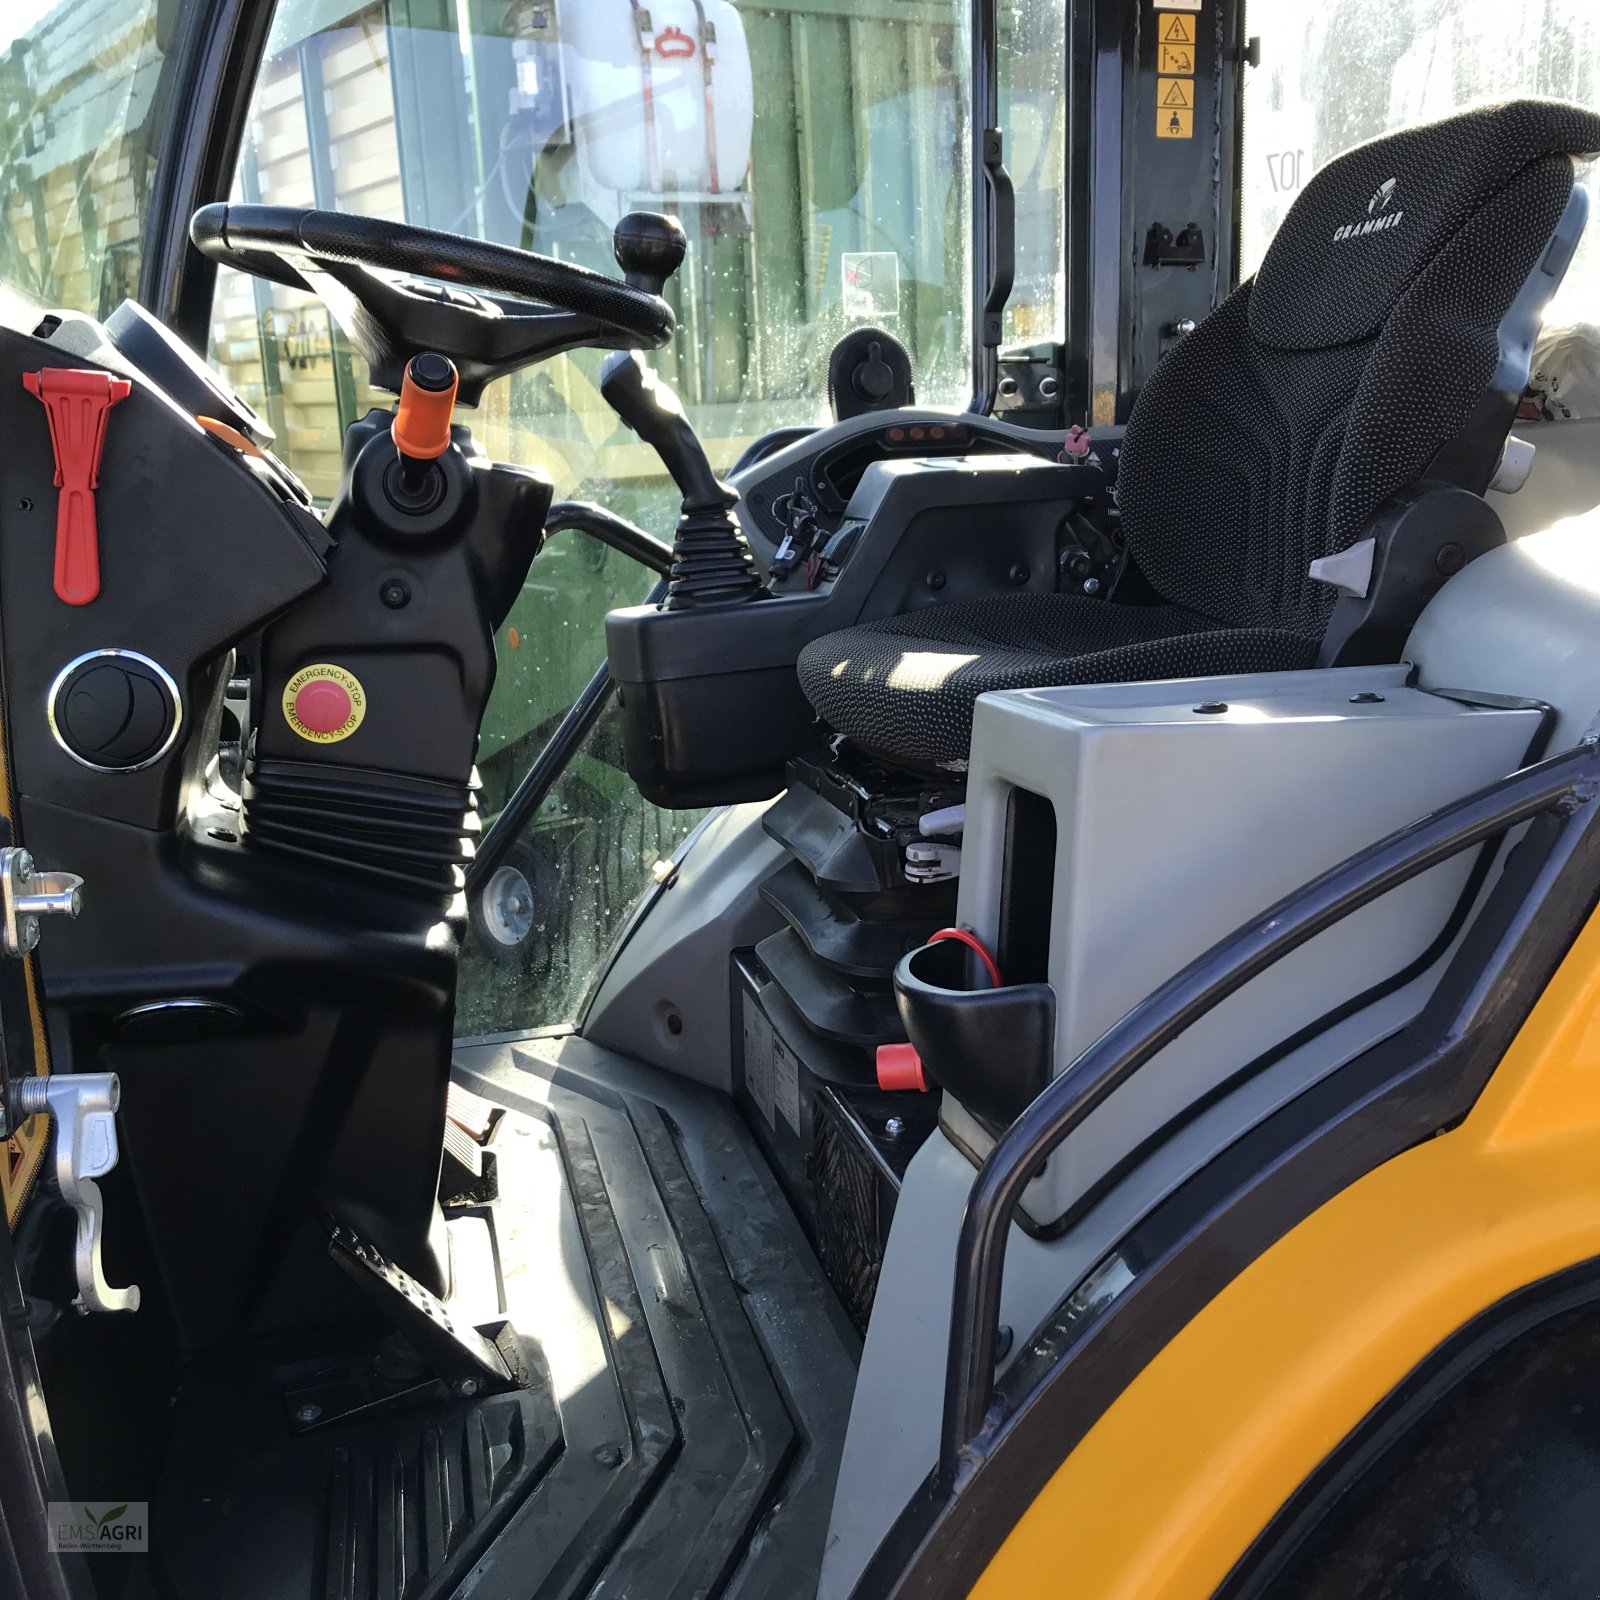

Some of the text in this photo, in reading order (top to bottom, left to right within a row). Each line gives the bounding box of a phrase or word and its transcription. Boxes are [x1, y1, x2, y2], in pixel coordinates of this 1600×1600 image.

[1333, 211, 1403, 241] GRAMMER
[289, 667, 362, 707] EMERGENCY-STOP
[286, 702, 357, 740] EMERGENCY-STOP
